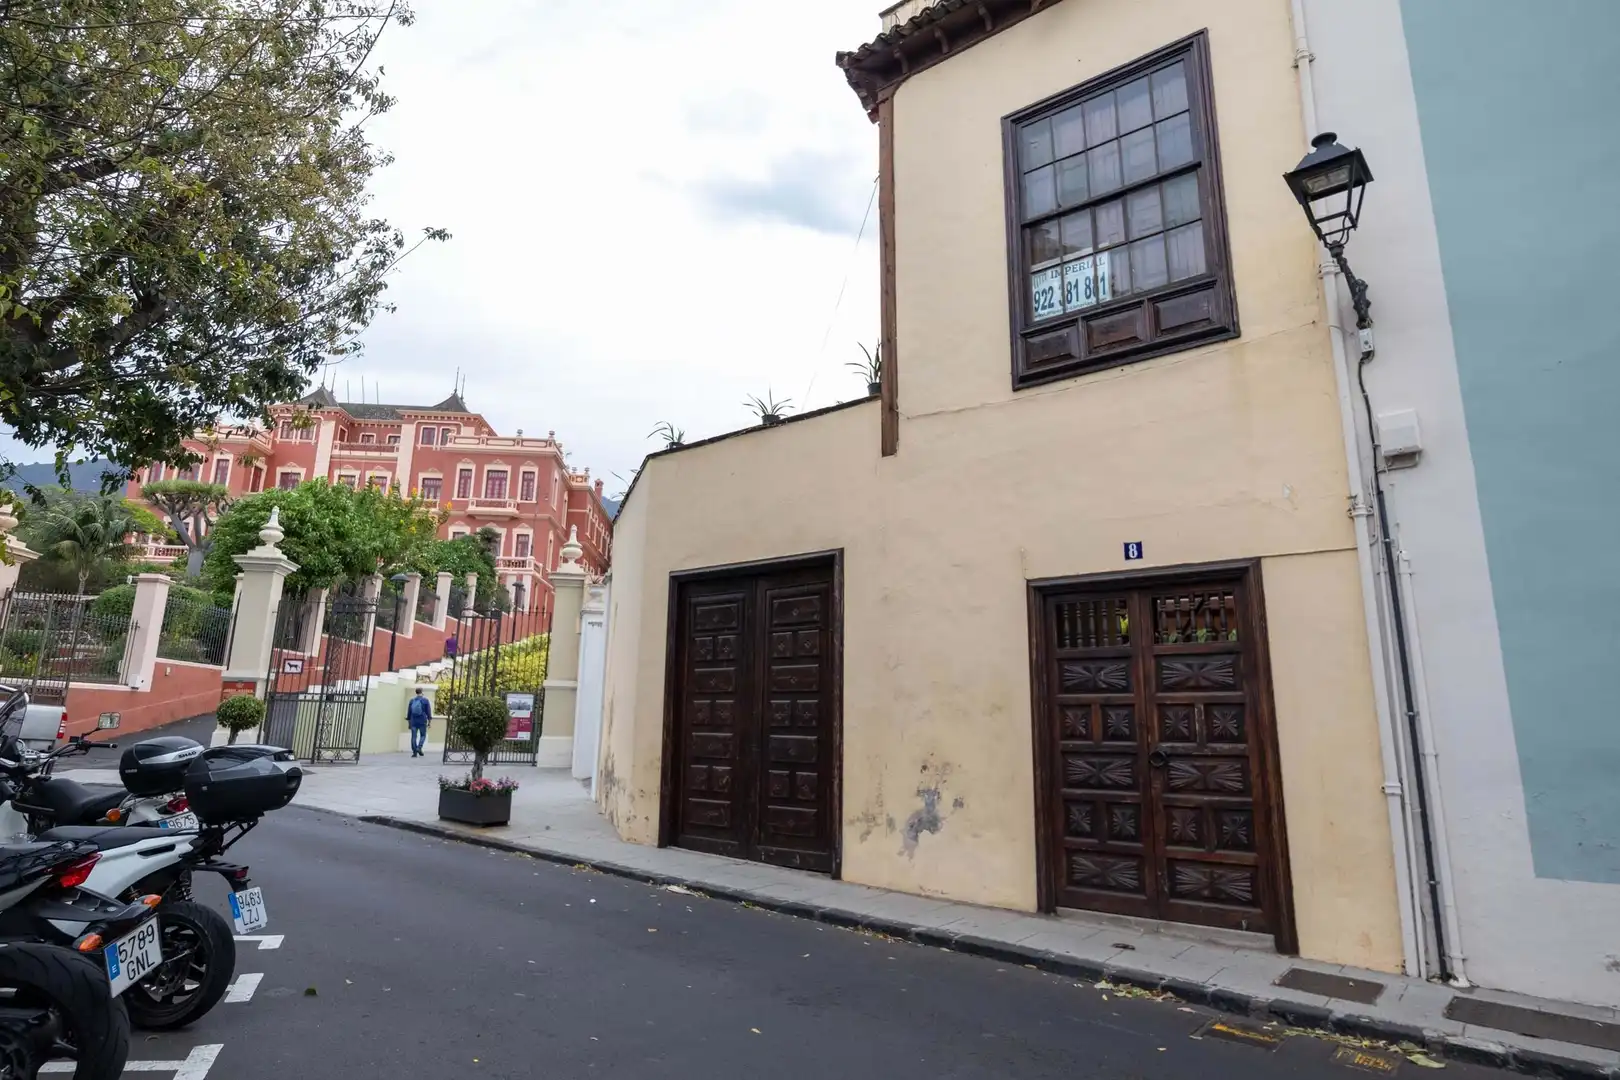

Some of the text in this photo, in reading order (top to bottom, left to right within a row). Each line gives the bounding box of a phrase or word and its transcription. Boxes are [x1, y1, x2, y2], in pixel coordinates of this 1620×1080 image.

[1033, 285, 1054, 312] 922
[1084, 271, 1106, 300] 81
[1128, 543, 1138, 558] 8
[178, 750, 197, 759] SHAD
[168, 814, 195, 829] 9675
[238, 891, 262, 910] 9463
[241, 907, 260, 926] LZJ
[117, 923, 155, 964] 5789
[126, 949, 156, 981] GNL
